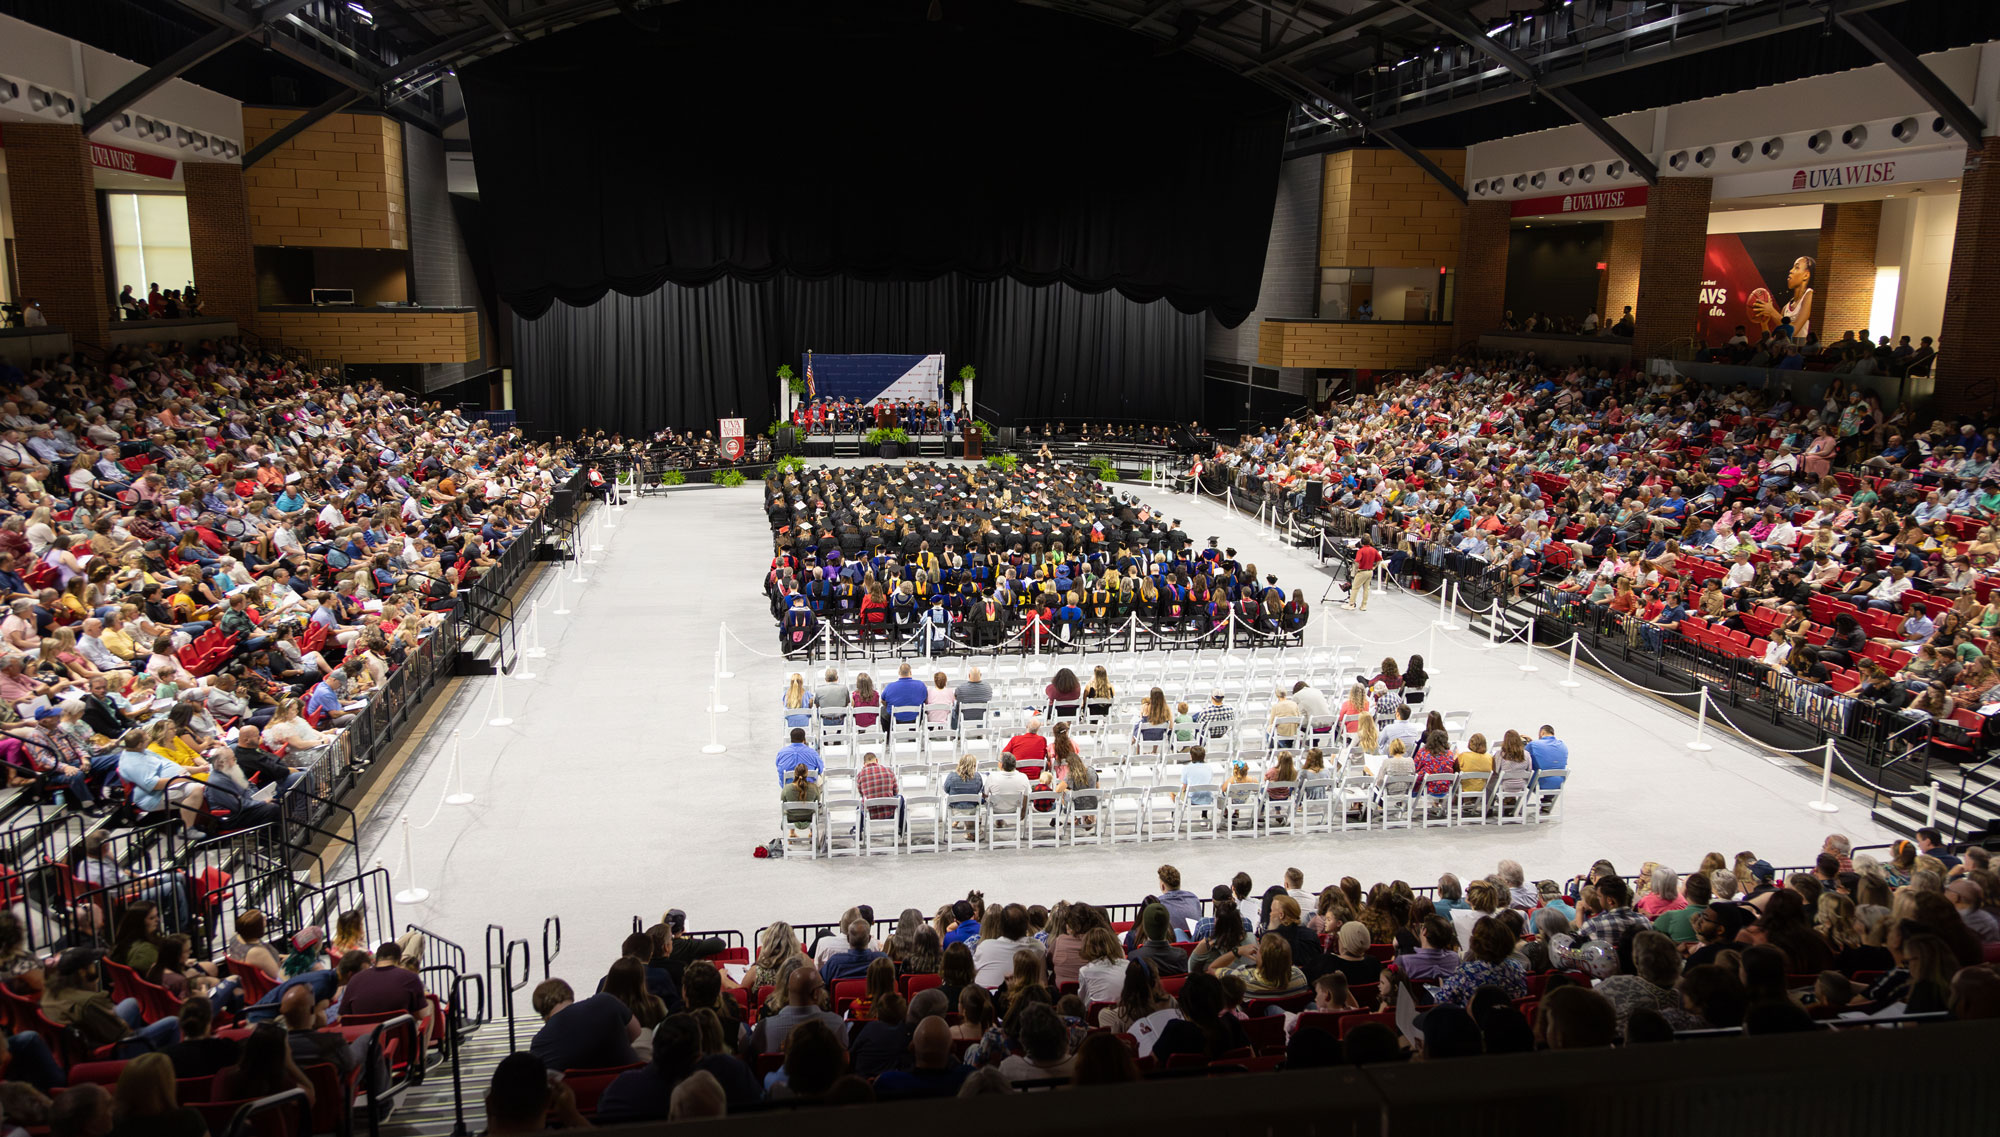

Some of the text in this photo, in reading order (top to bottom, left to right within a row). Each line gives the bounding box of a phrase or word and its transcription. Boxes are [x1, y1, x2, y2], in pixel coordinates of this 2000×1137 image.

[90, 145, 136, 171] UVA WISE
[1809, 161, 1896, 188] UVA WISE
[1573, 191, 1625, 211] UVA WISE
[1709, 305, 1726, 317] do.
[723, 420, 741, 428] UVA
